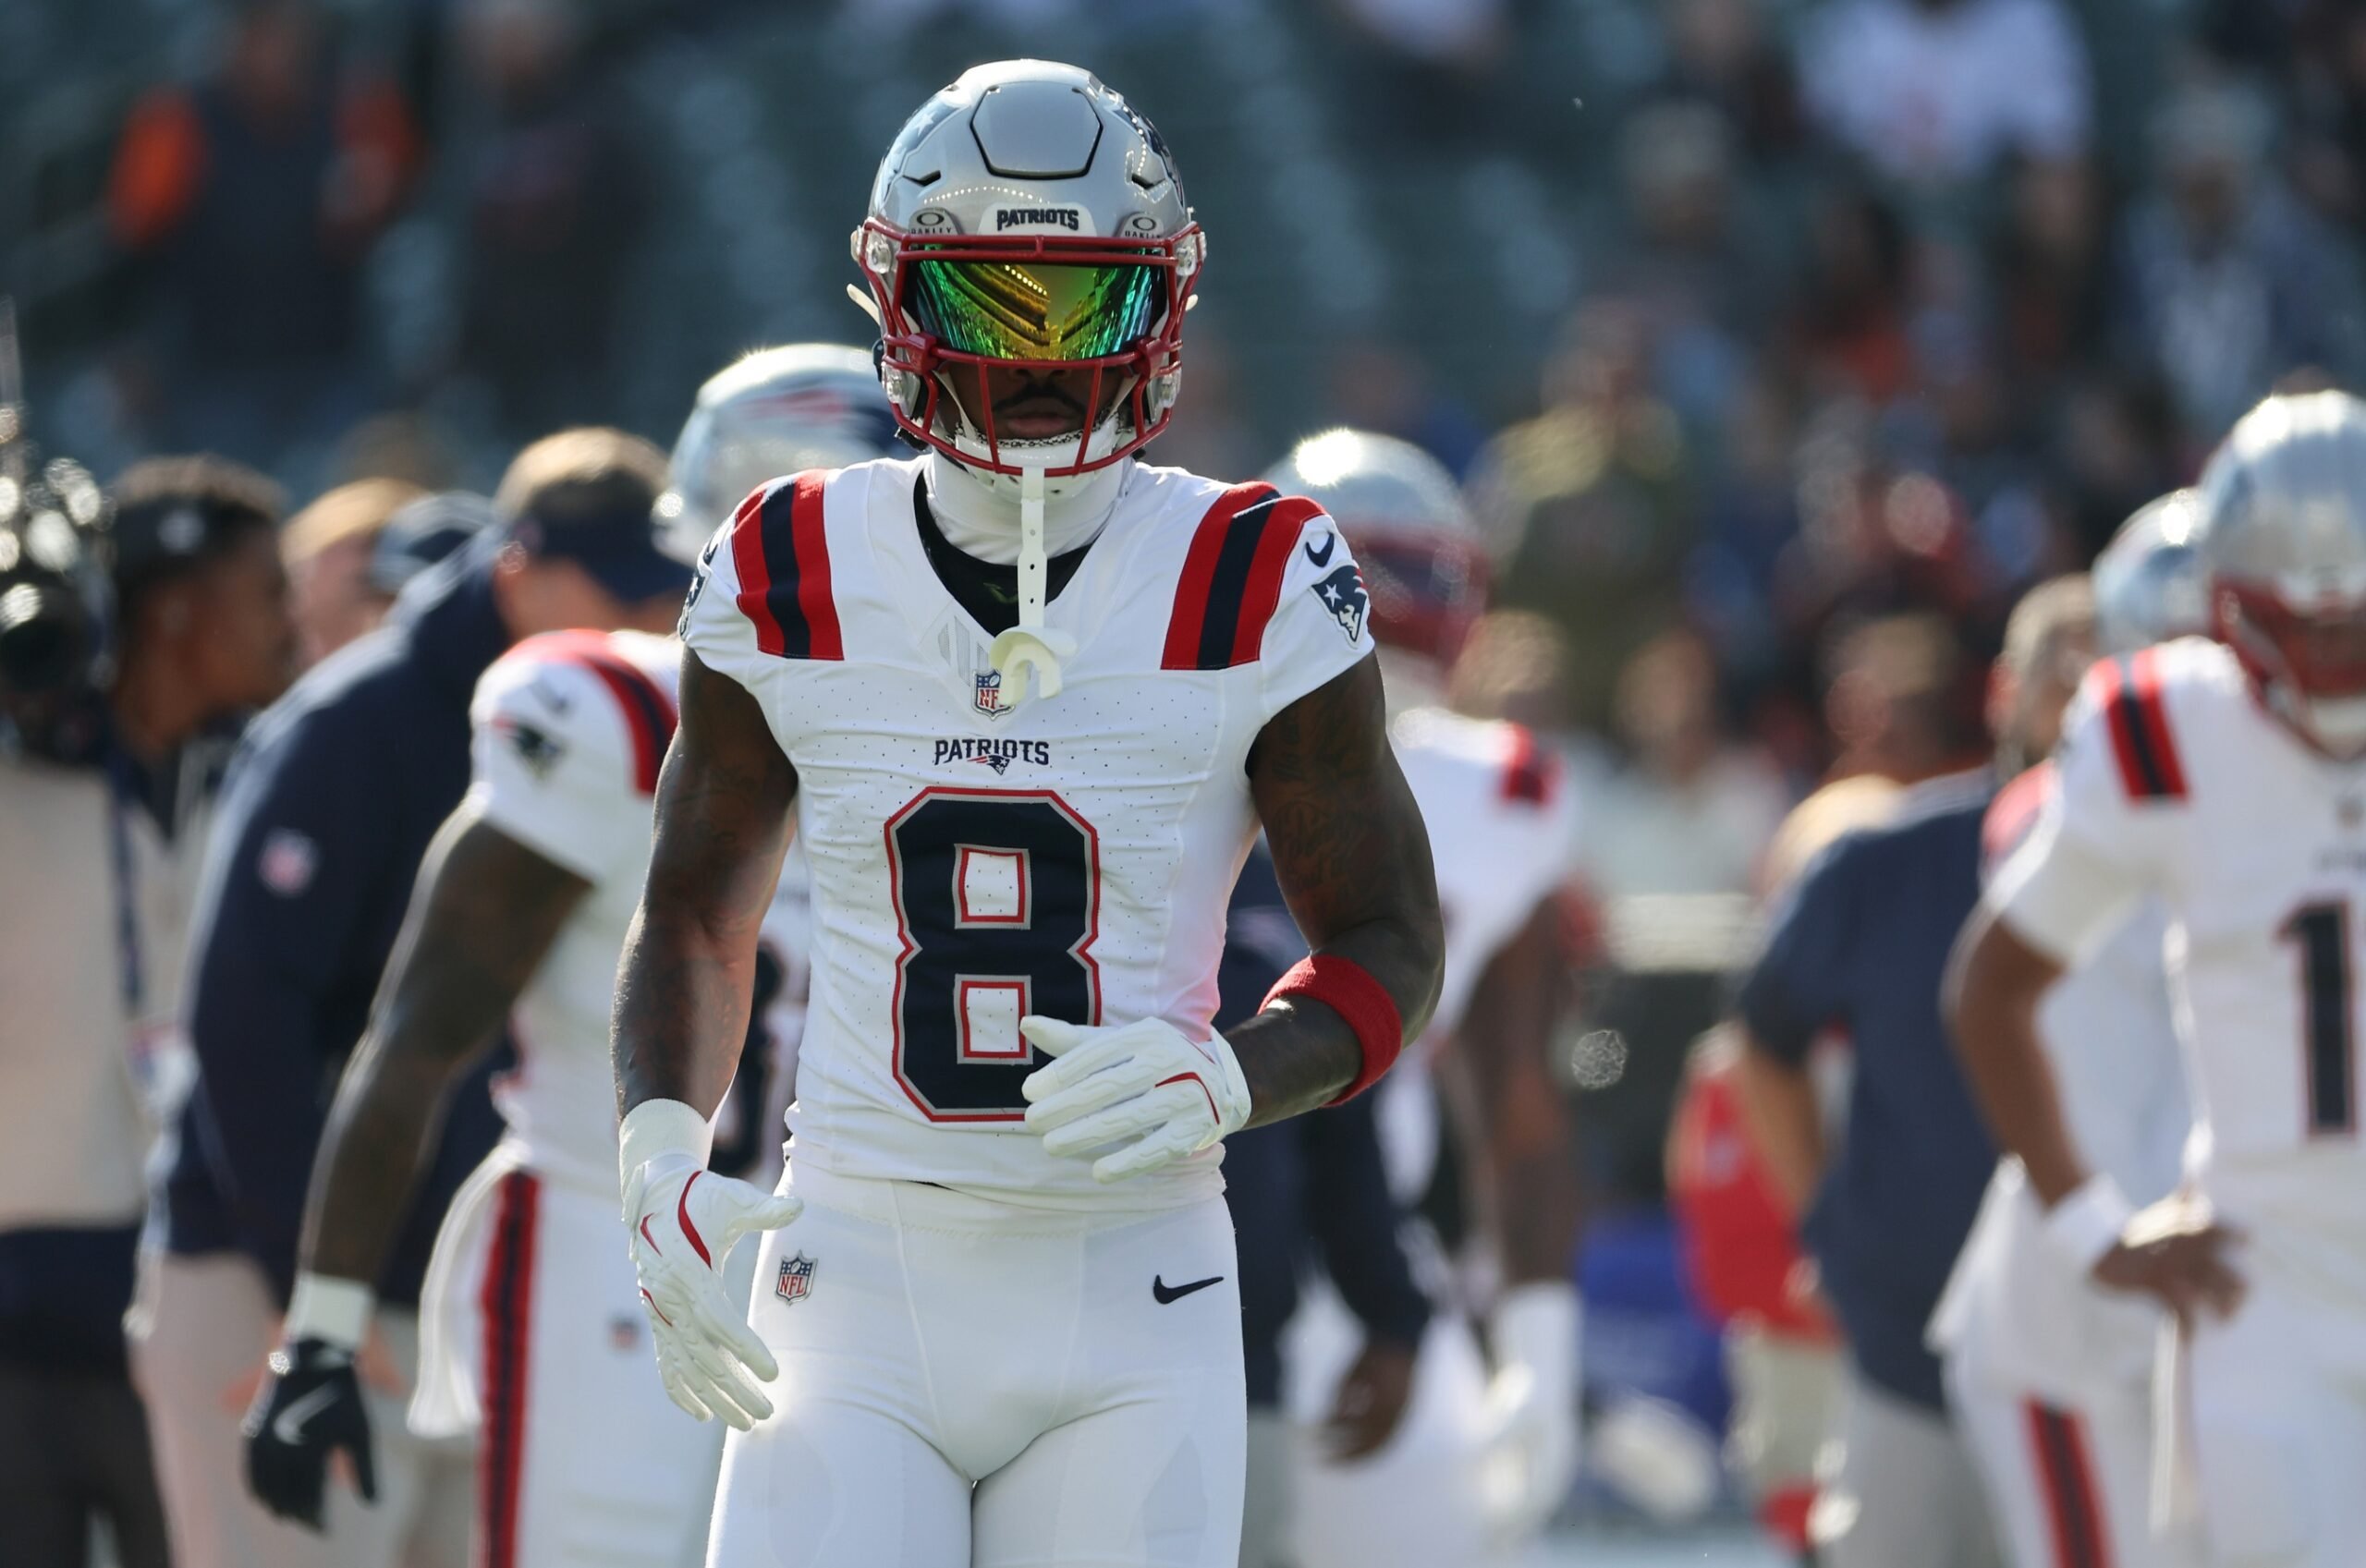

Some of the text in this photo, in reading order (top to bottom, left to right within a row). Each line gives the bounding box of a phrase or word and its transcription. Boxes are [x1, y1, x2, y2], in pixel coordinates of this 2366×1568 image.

[996, 209, 1079, 231] PATRIOTS
[979, 688, 1006, 710] NF
[934, 738, 1050, 765] PATRIOTS
[884, 786, 1102, 1122] 8
[779, 1275, 805, 1296] NFL
